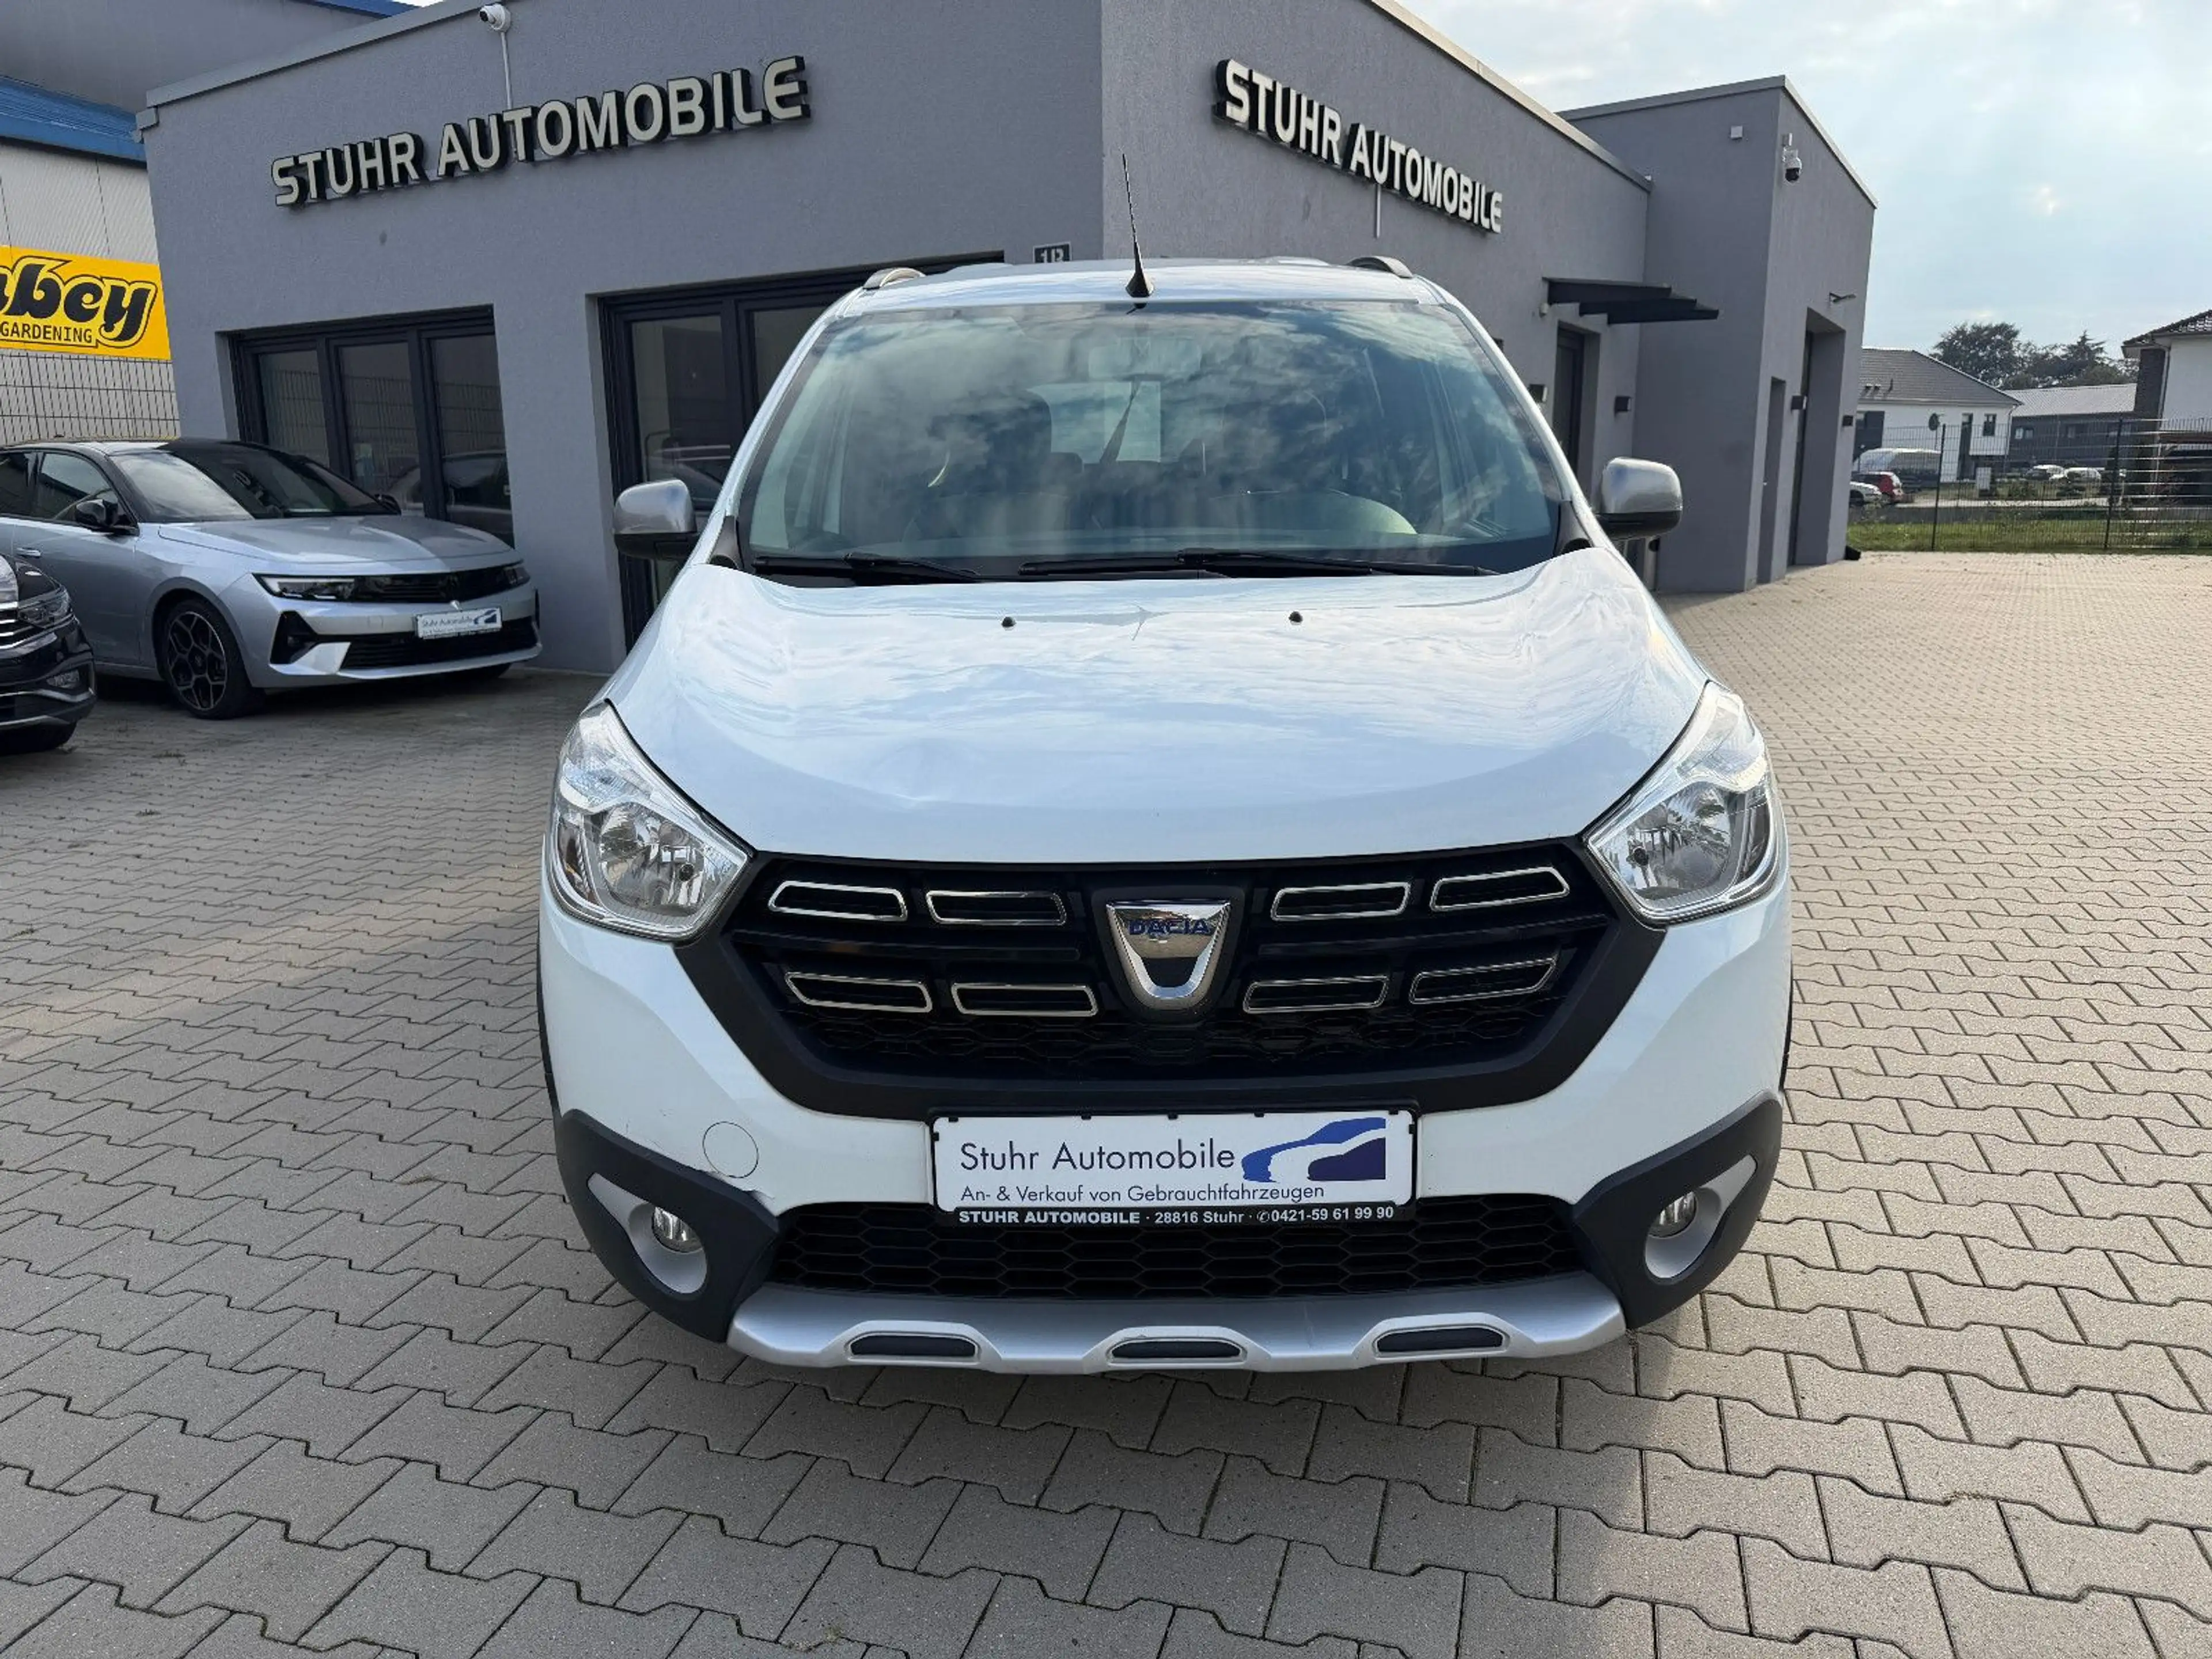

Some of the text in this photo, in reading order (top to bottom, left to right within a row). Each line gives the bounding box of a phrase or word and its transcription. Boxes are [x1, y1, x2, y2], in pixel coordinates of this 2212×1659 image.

[271, 56, 809, 206] STUHR AUTOMOBILE
[1217, 59, 1503, 233] STUHR AUTOMOBILE
[0, 321, 93, 343] GARDENING
[961, 1138, 1235, 1171] Stuhr Automobile
[961, 1183, 1324, 1203] An- & Verkauf von Gebrauchtfahrzeugen
[960, 1211, 1020, 1224] STUHR
[1024, 1211, 1140, 1224] AUTOMOBILE
[1154, 1211, 1198, 1224] 28816
[1203, 1210, 1244, 1223] Stuhr
[1332, 1209, 1350, 1221] 61
[1354, 1208, 1374, 1221] 99
[1377, 1207, 1394, 1220] 90
